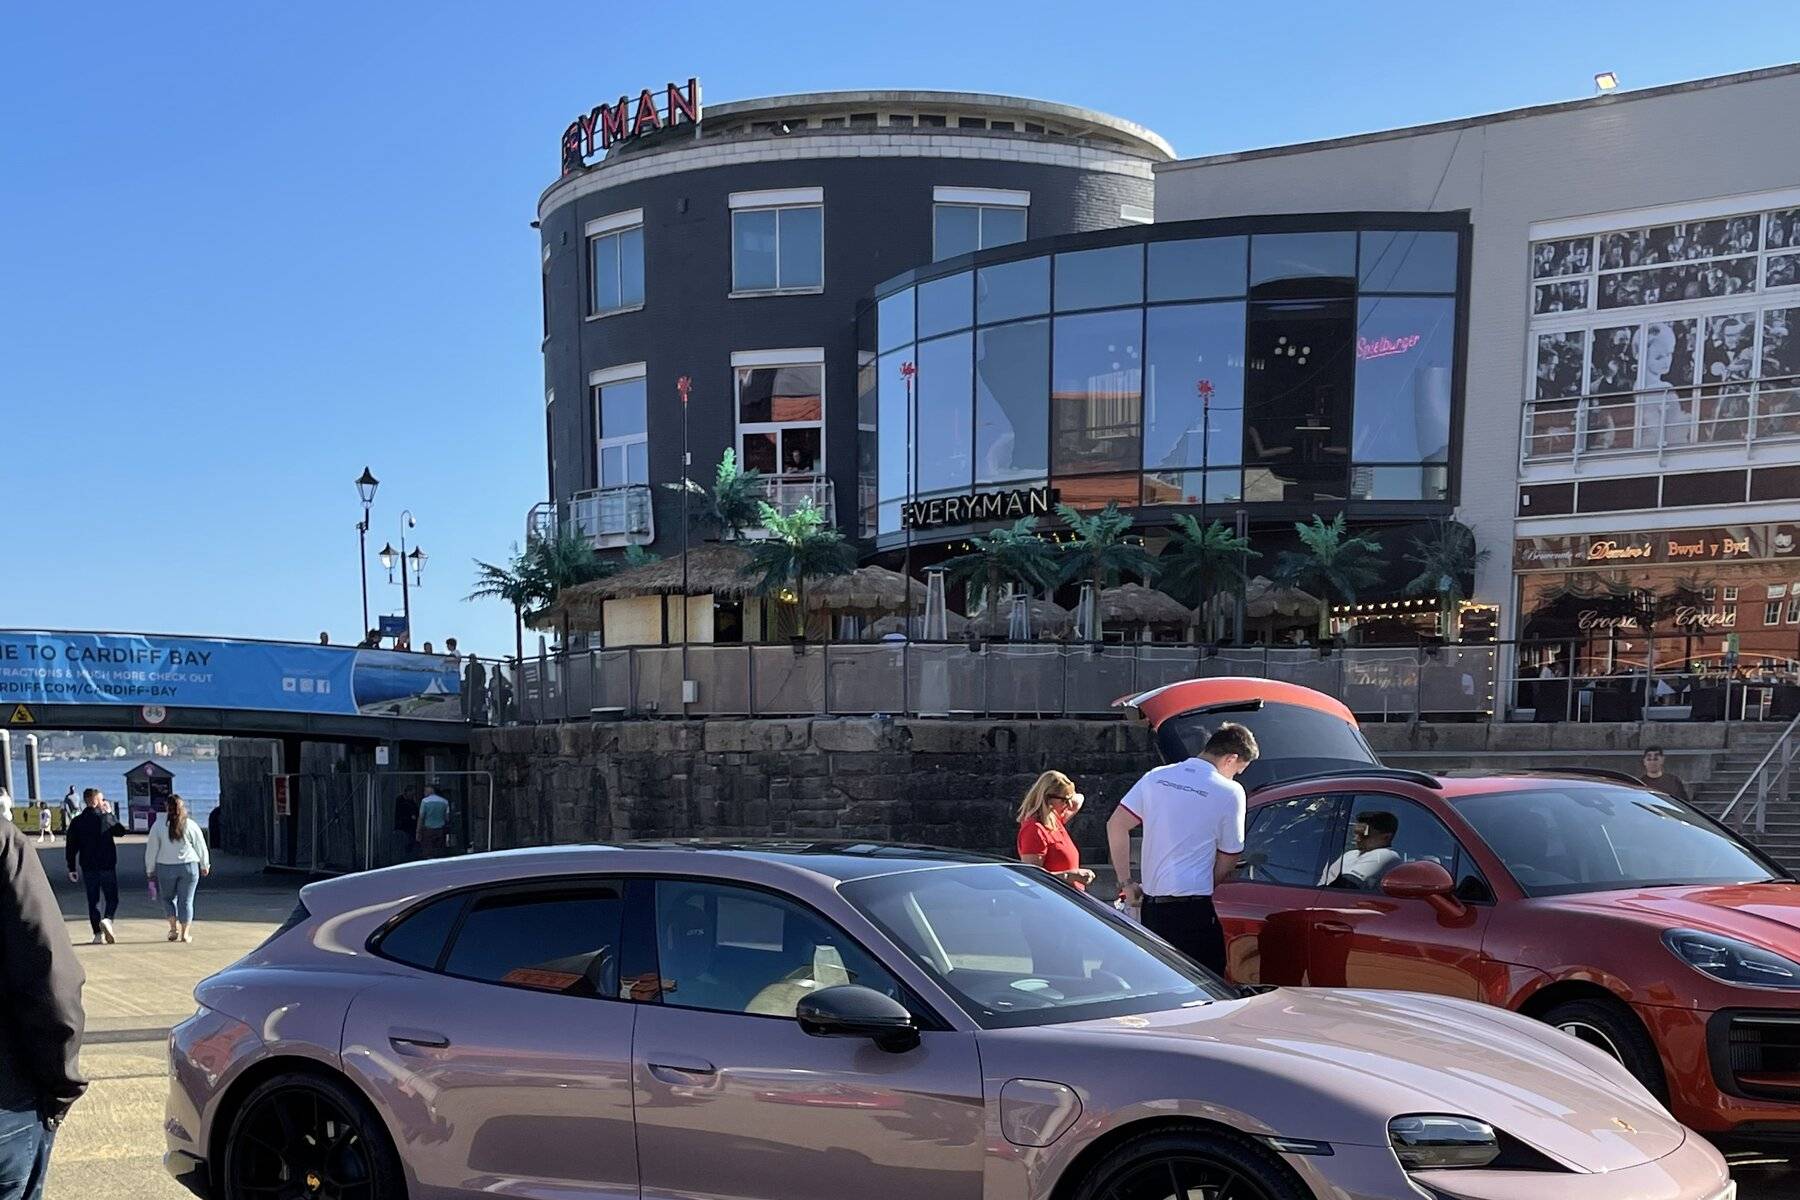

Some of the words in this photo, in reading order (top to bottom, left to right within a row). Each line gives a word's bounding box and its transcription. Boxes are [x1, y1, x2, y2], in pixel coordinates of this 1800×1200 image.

[901, 487, 1049, 528] EVERYMAN
[1667, 540, 1704, 557] Bwyd
[1723, 537, 1750, 555] Byd
[26, 645, 56, 661] TO
[65, 646, 161, 664] CARDIFF
[169, 648, 211, 666] BAY
[0, 667, 63, 679] RACTIONS
[113, 671, 146, 682] MORE
[149, 672, 186, 683] CHECK
[189, 673, 213, 684] OUT
